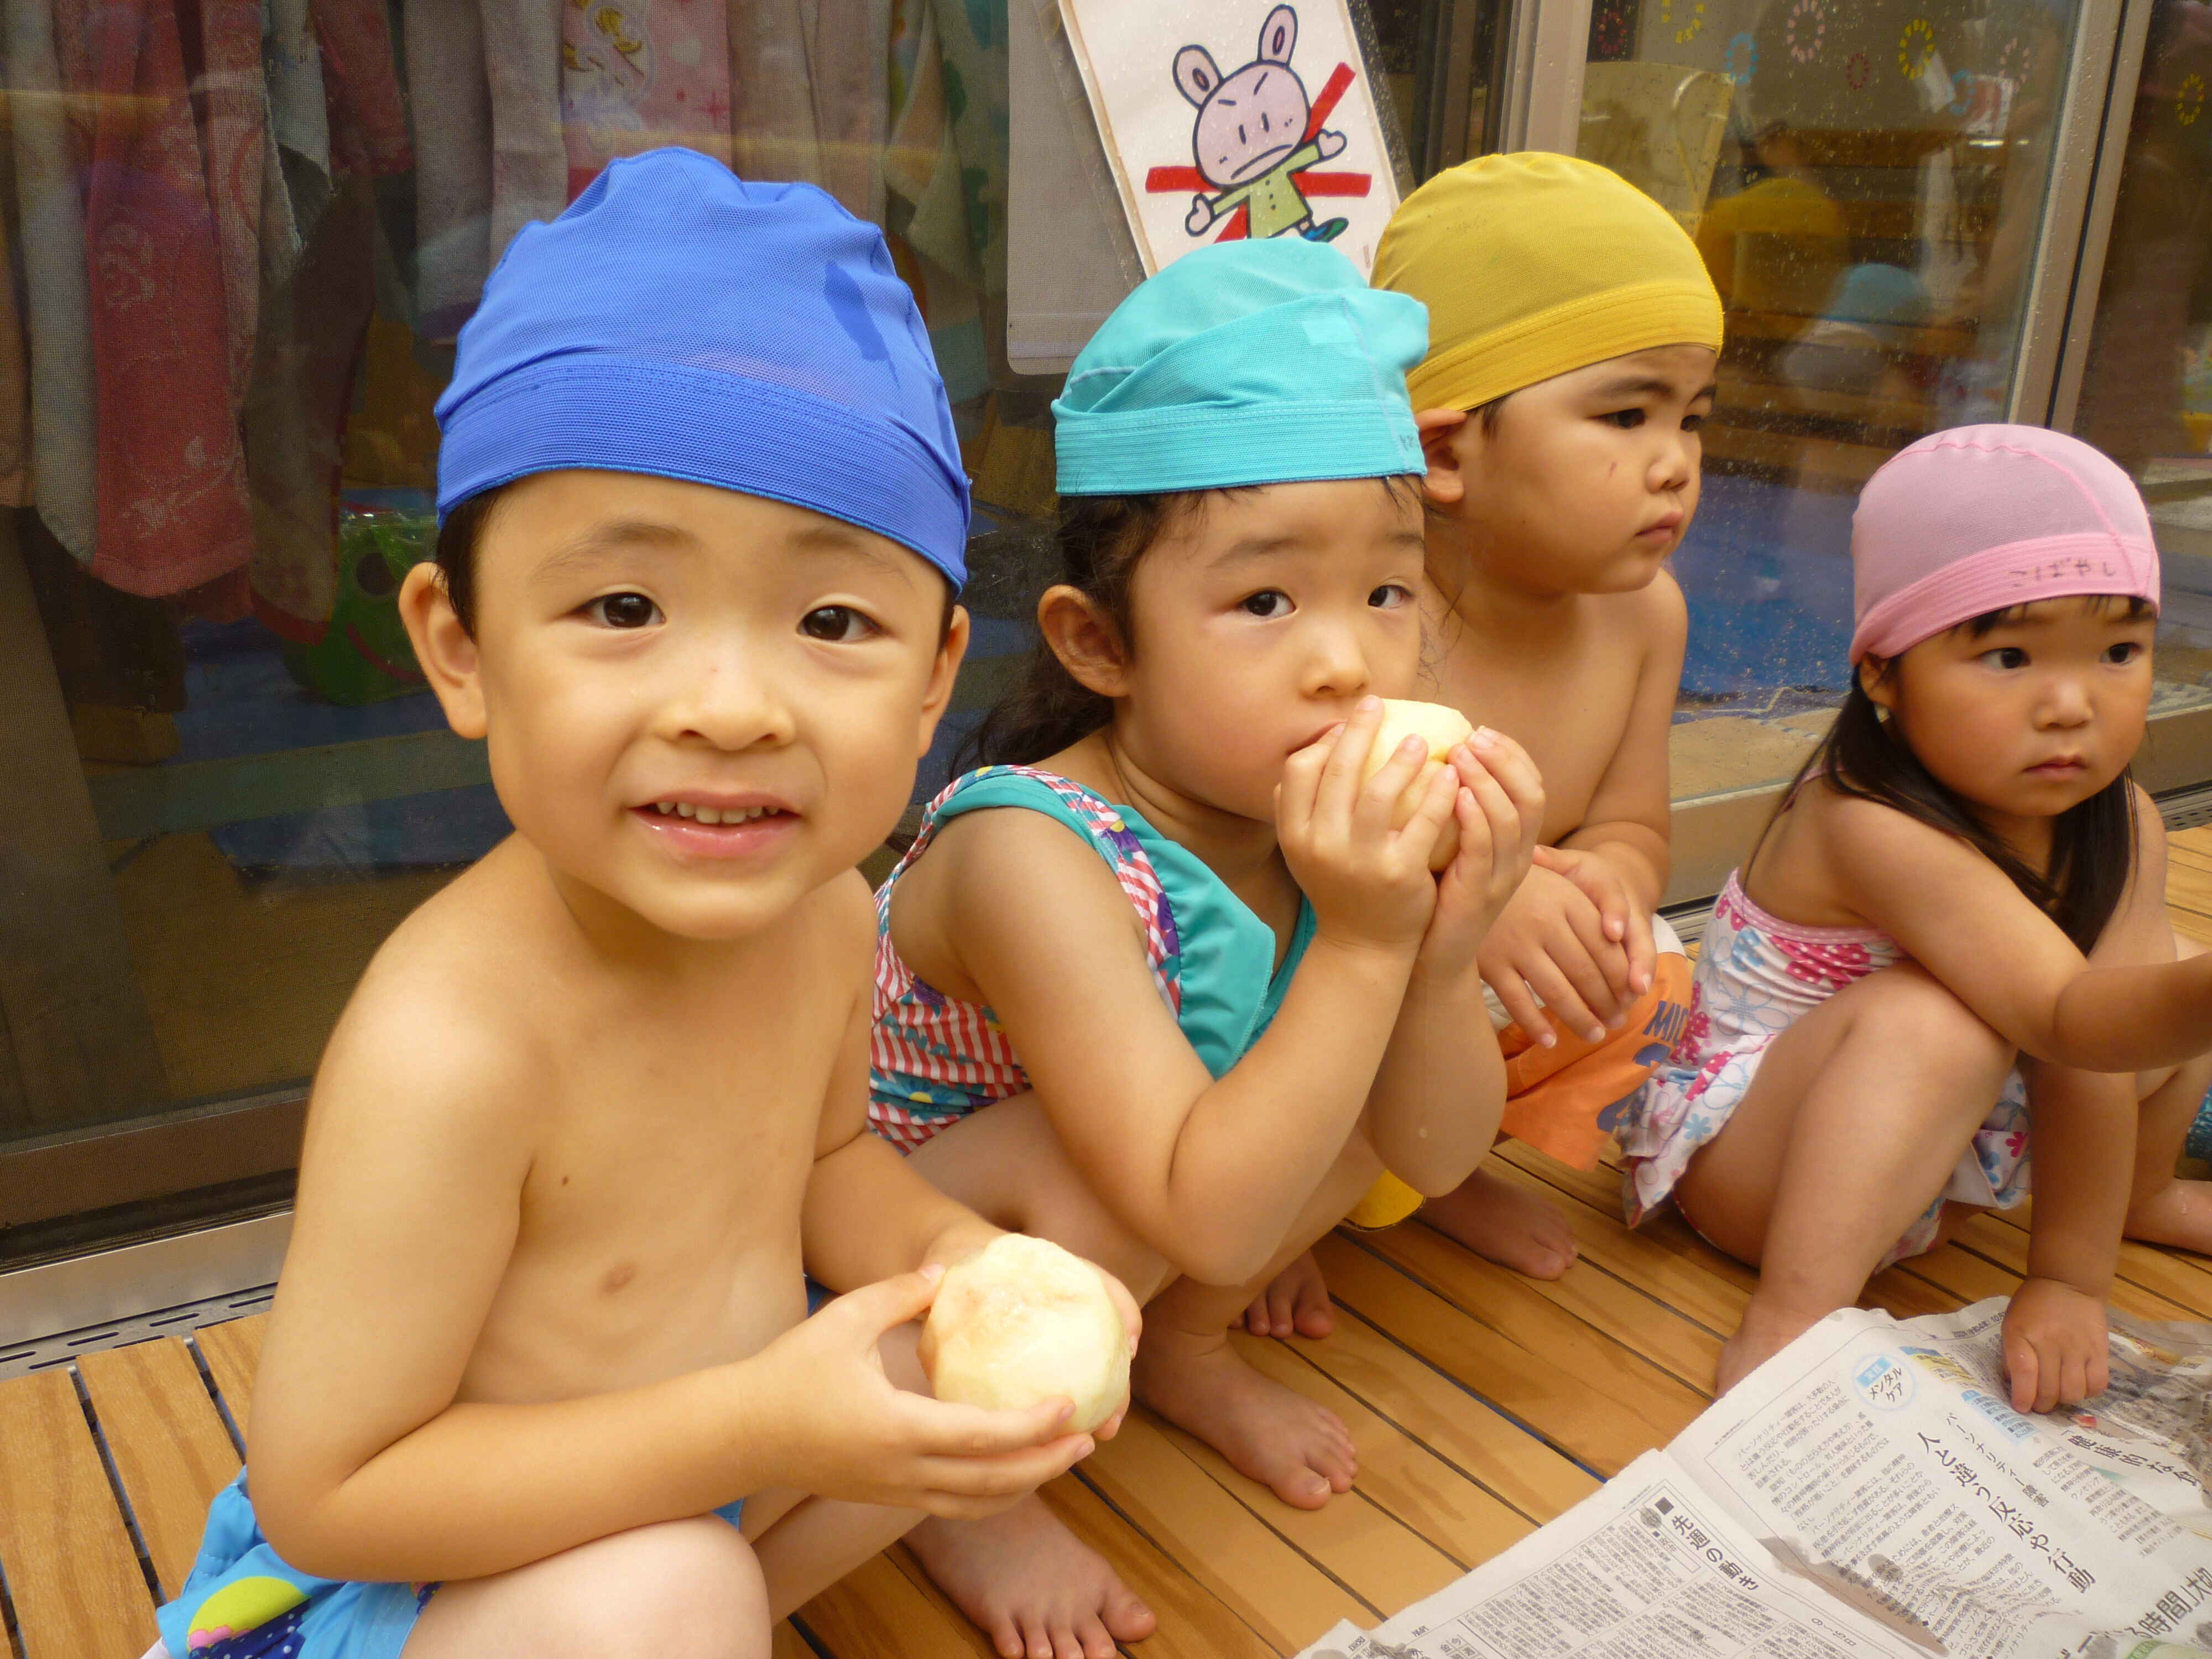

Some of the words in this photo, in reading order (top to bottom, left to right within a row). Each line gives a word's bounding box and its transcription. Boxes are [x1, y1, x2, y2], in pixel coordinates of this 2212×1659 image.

[2008, 556, 2117, 587] こばやし
[1869, 1368, 1901, 1400] メンタル
[1885, 1382, 1902, 1402] ケア
[1946, 1411, 2049, 1507] パーソナリティー障害
[1918, 1431, 2096, 1594] 人と違う反応や行動
[1675, 1515, 1759, 1590] 先週の動き
